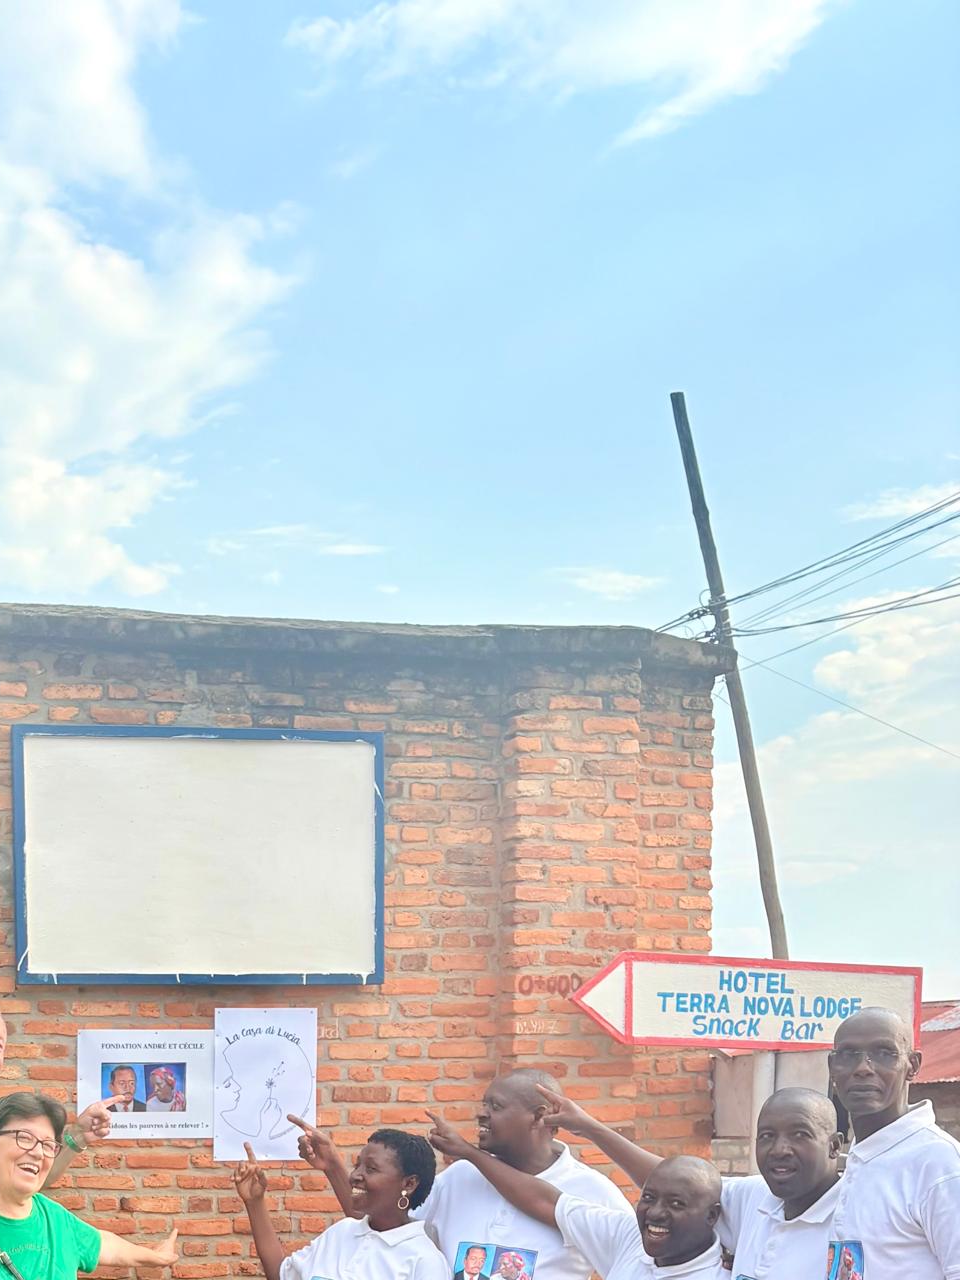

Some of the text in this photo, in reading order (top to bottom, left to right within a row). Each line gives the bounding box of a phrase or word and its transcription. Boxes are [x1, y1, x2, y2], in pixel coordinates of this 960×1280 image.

[719, 970, 795, 994] HOTEL
[656, 991, 863, 1019] TERRA NOVA LODGE
[277, 1027, 301, 1045] Lucia
[692, 1014, 824, 1041] Snack Bar
[101, 1041, 205, 1050] FONDATION ANDRÉ ET CÉCILE
